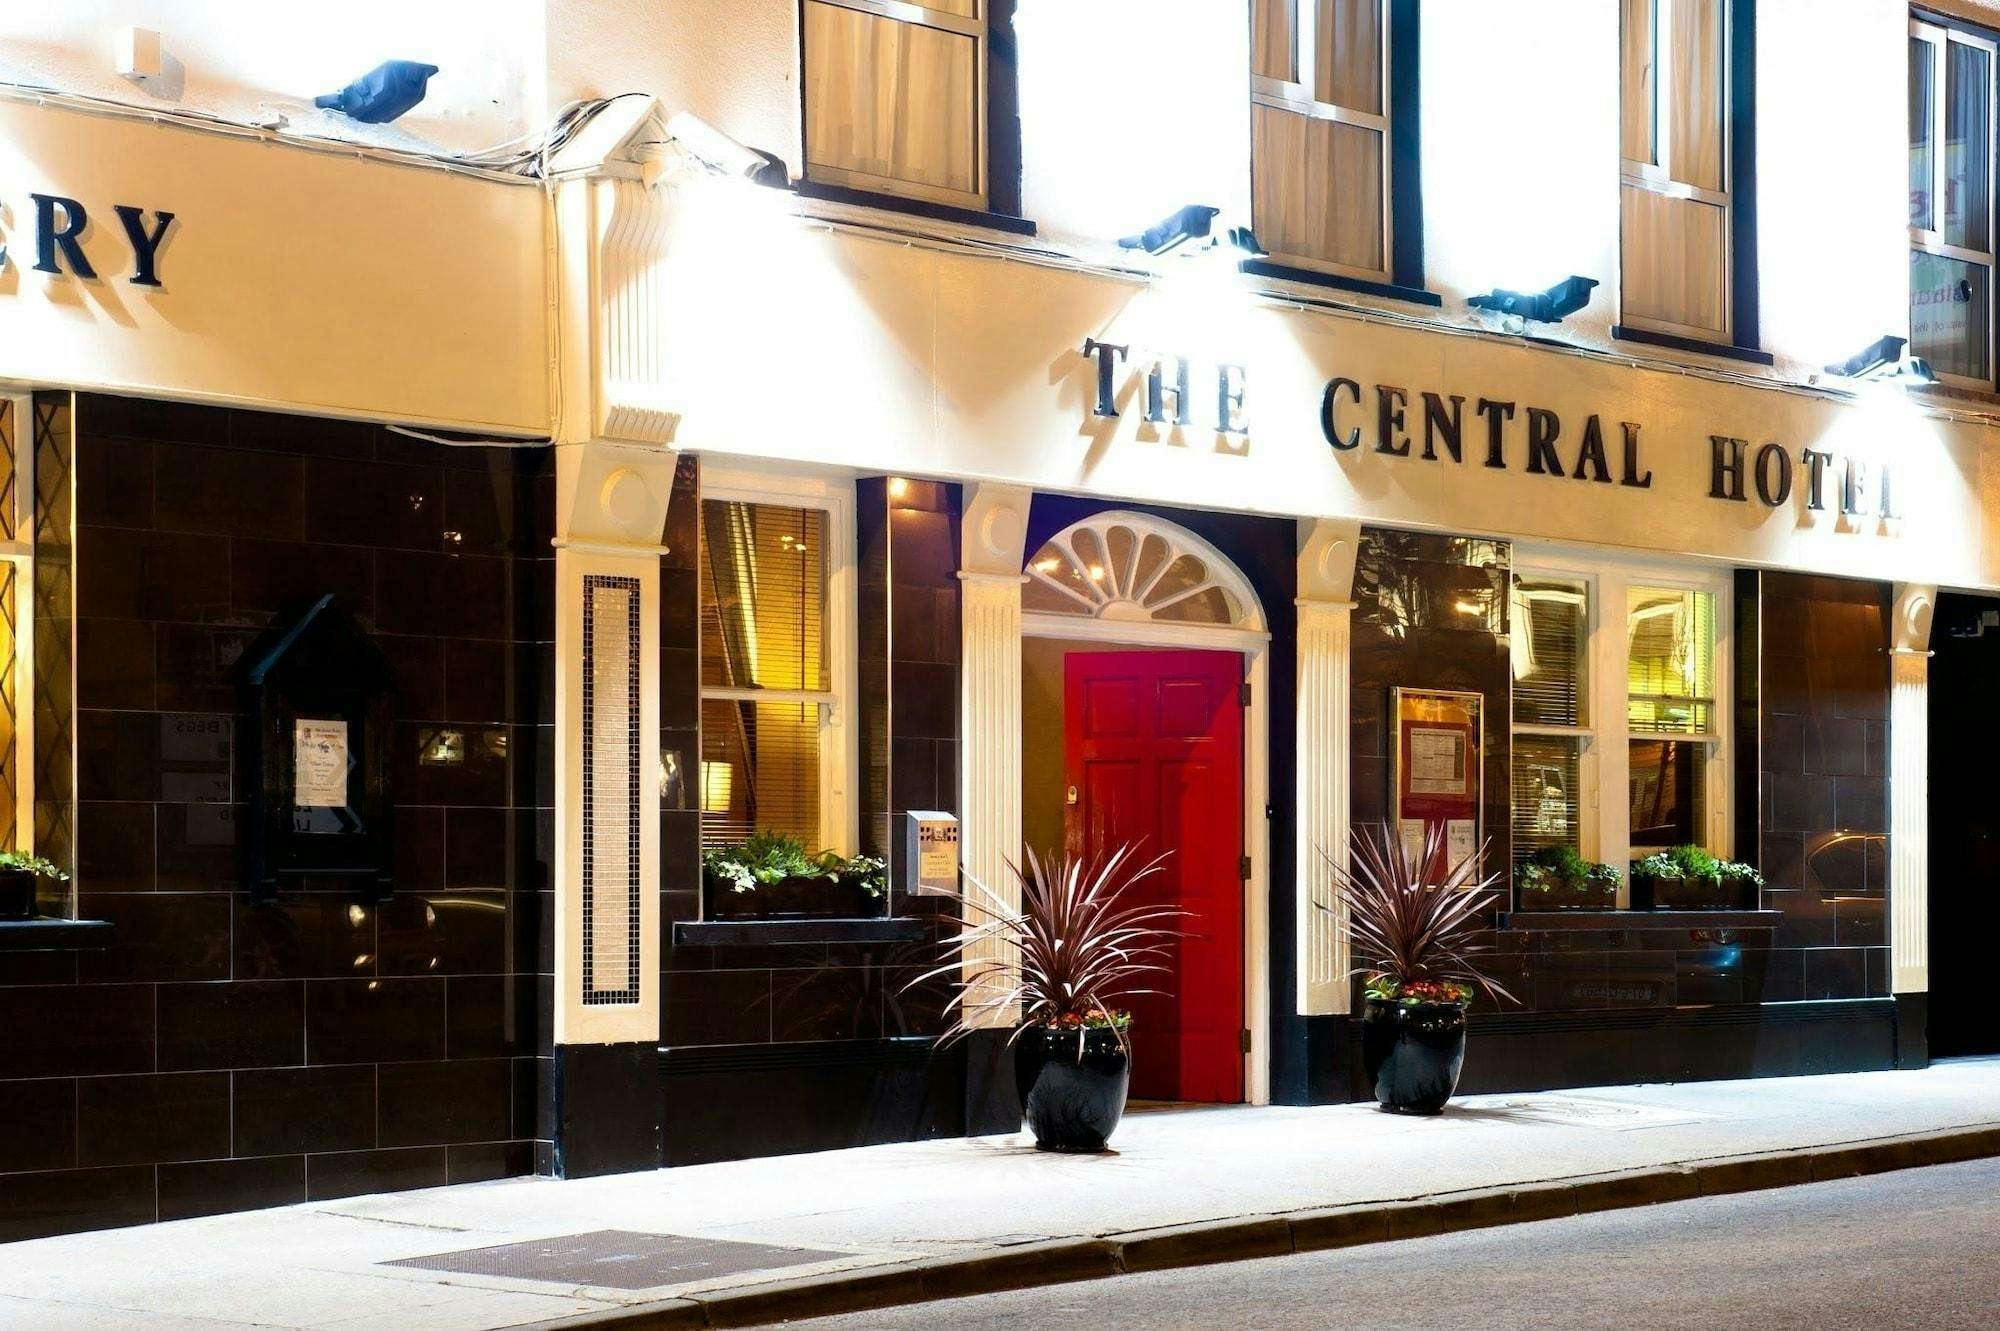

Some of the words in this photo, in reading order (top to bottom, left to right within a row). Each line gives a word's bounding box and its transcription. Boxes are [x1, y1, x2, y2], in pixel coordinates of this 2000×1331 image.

[0, 193, 175, 287] RY
[1083, 337, 1249, 435] THE
[1321, 377, 1652, 489] CENTRAL
[1708, 434, 1902, 520] HOTEL
